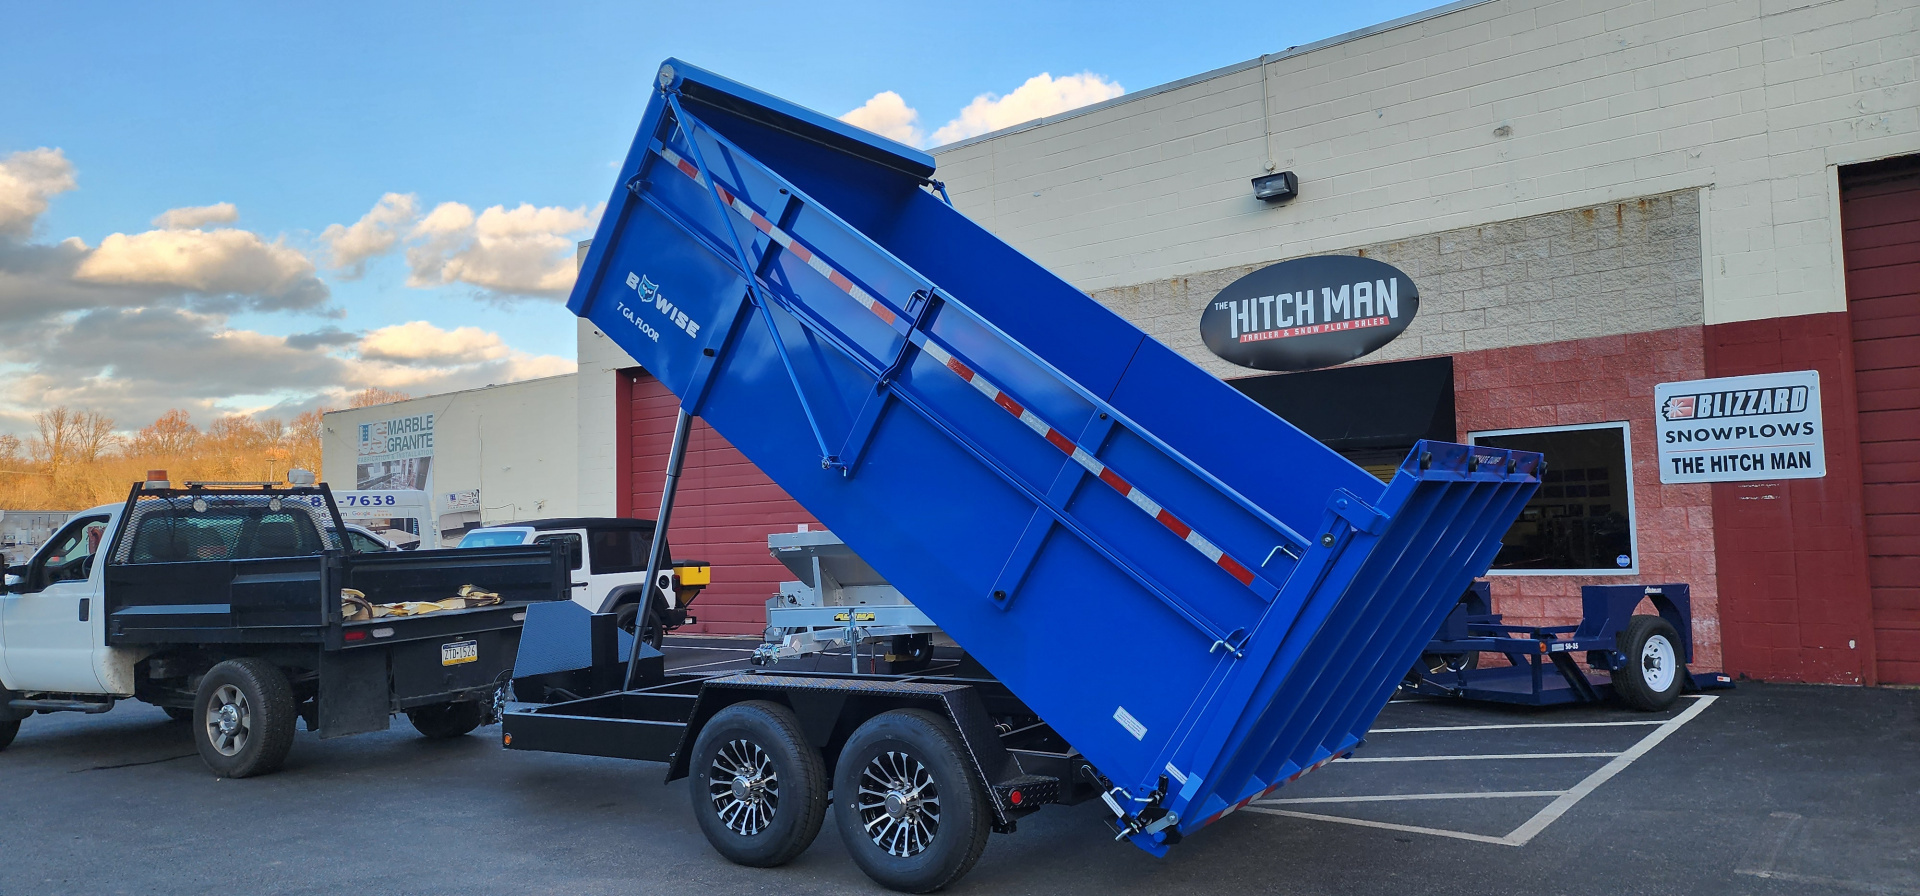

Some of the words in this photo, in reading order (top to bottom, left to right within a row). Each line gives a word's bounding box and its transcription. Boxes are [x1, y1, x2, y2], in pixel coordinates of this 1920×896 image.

[616, 301, 624, 311] 7
[634, 316, 660, 343] FLOOR
[1214, 301, 1229, 311] THE
[1229, 289, 1315, 339] HITCH
[1321, 277, 1399, 322] MAN
[1243, 330, 1279, 342] TRAILER
[1283, 329, 1290, 337] &
[1294, 325, 1320, 336] SNOW
[1324, 321, 1350, 331] PLOW
[1354, 317, 1385, 328] SALES
[1697, 386, 1806, 418] BLIZZARD
[359, 422, 387, 456] US
[387, 414, 434, 436] MARBLE
[387, 432, 433, 453] GRANITE
[1665, 421, 1814, 444] SNOWPLOWS
[1671, 456, 1705, 475] THE
[1710, 453, 1765, 473] HITCH
[1770, 451, 1812, 470] MAN
